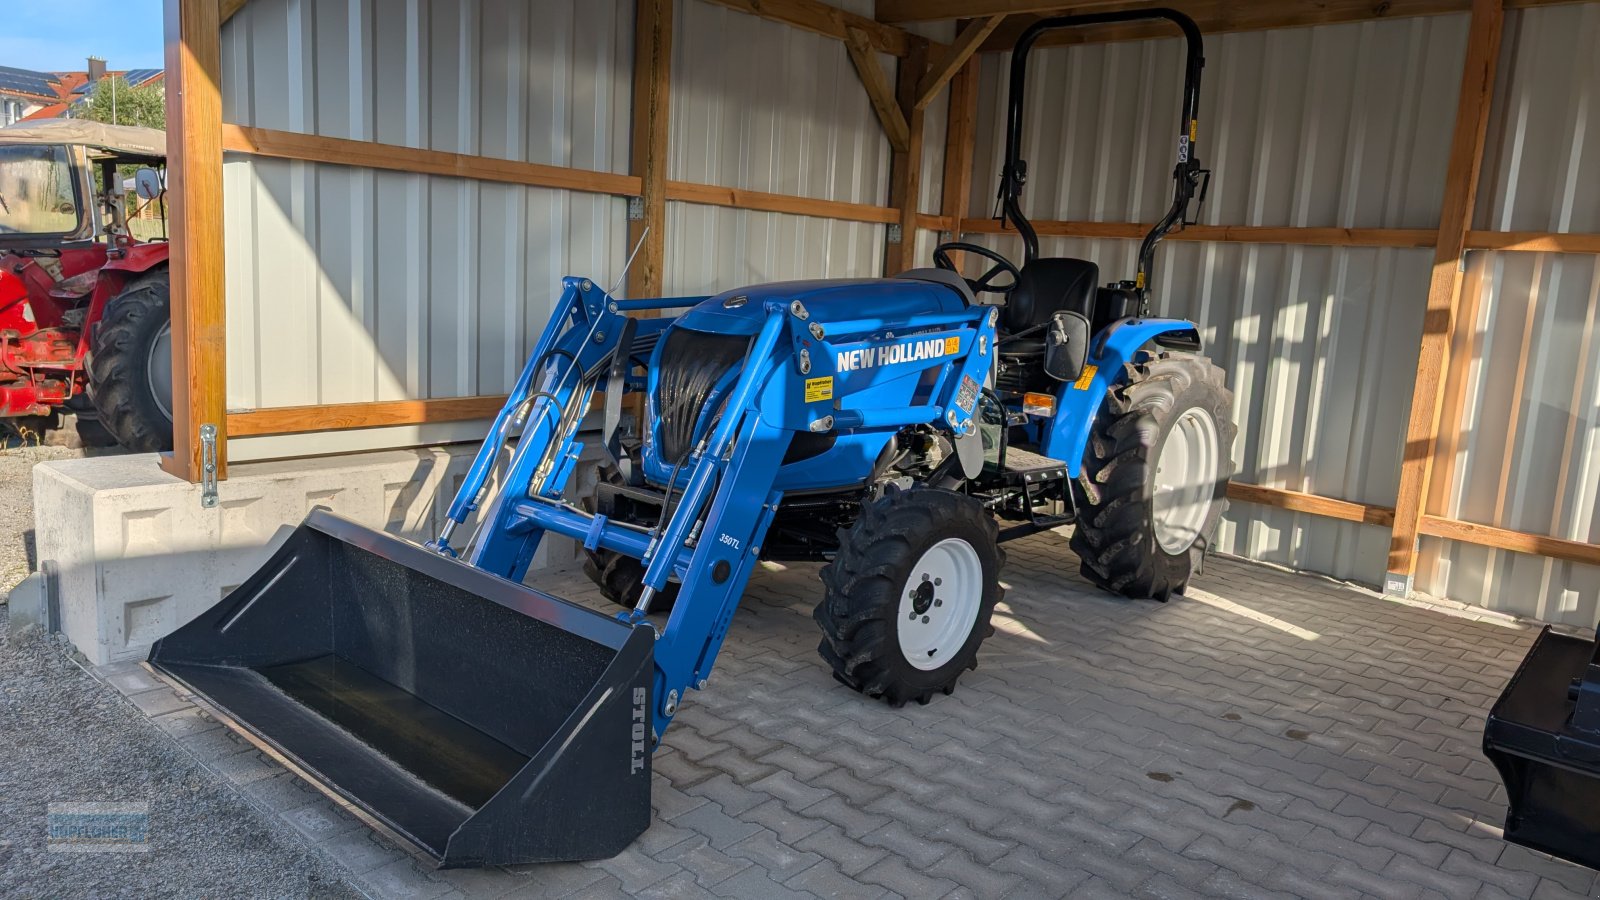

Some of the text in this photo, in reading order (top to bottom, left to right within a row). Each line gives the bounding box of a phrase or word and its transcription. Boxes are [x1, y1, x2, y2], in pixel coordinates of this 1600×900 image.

[837, 338, 944, 373] NEW HOLLAND
[719, 533, 740, 550] 350TL
[631, 687, 646, 775] STOLL
